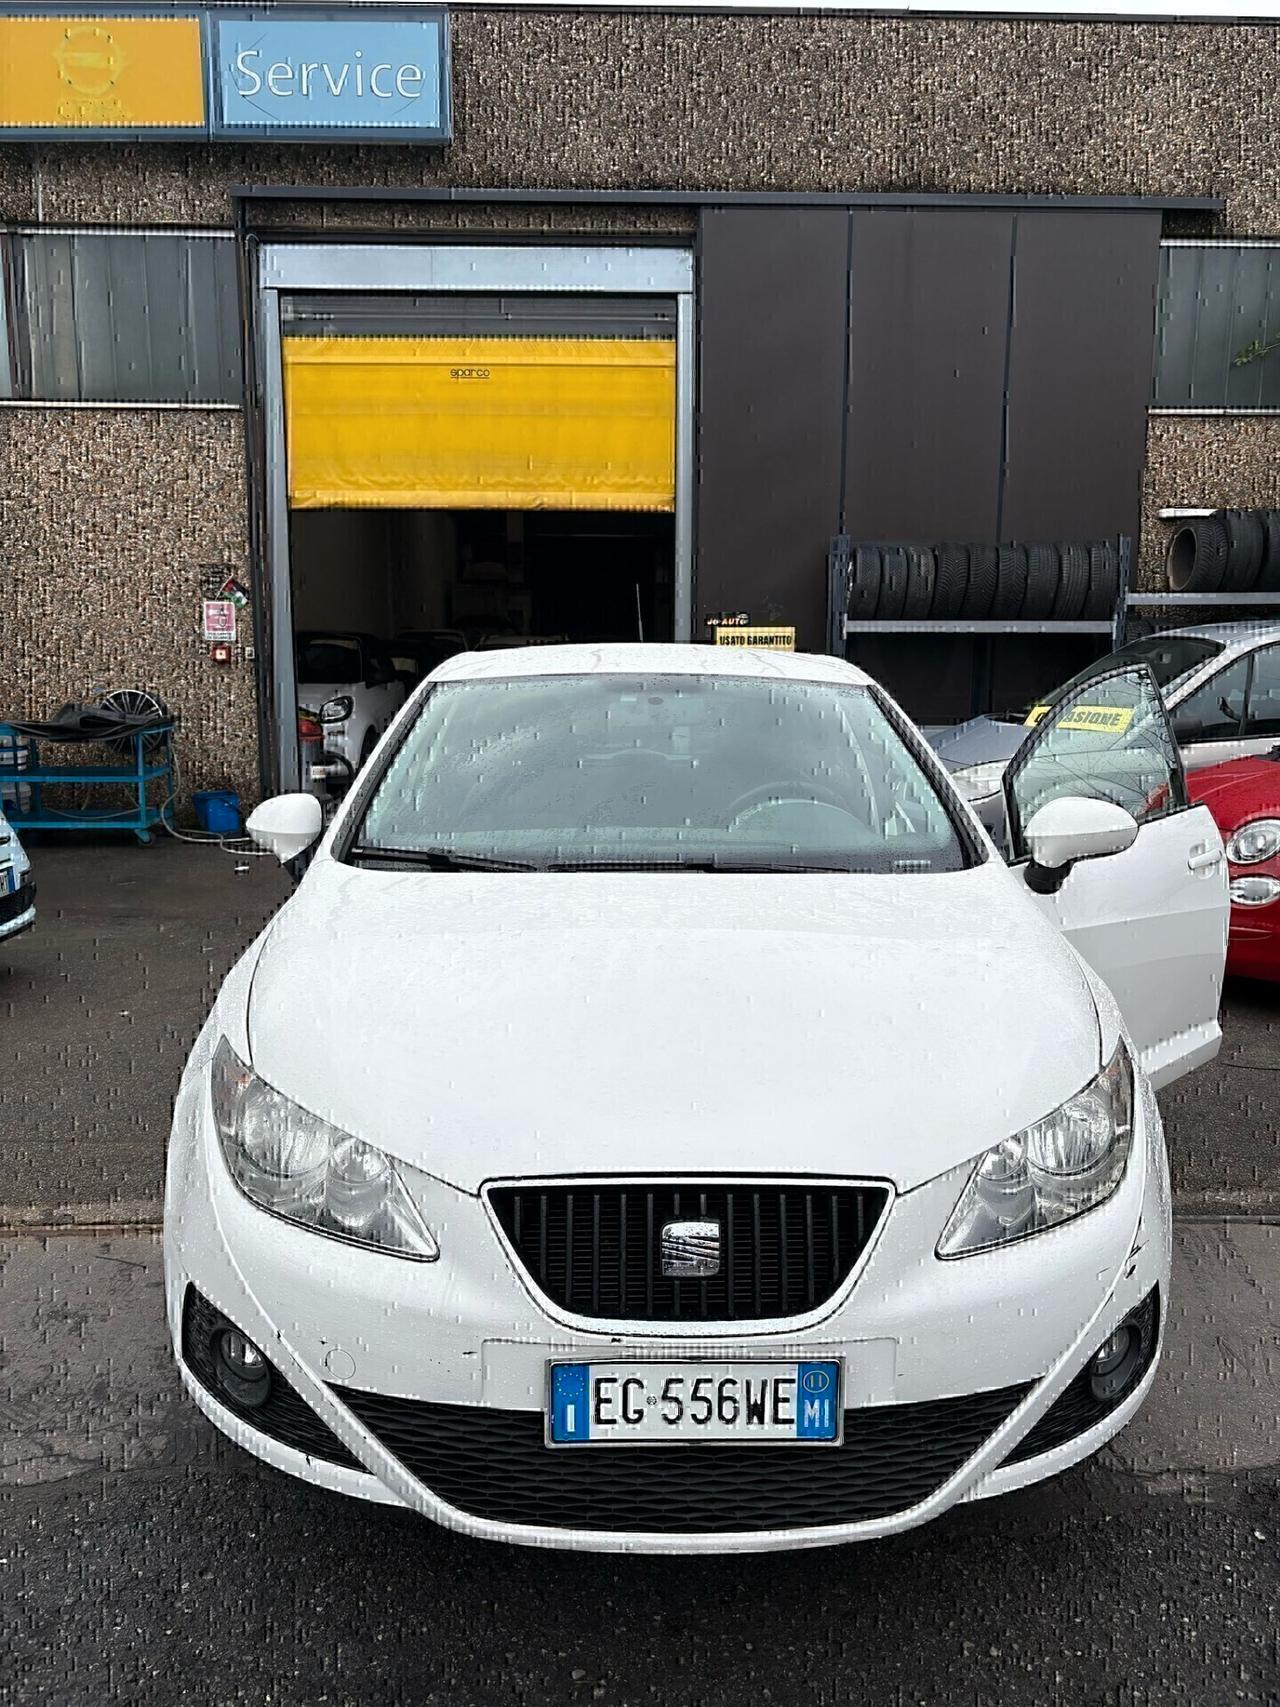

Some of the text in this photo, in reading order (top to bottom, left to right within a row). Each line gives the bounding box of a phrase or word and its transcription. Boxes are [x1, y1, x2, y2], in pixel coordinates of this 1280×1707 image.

[236, 50, 422, 98] Service
[450, 368, 490, 380] sparco
[720, 635, 792, 645] USATO GARANTITO
[594, 1377, 796, 1426] EG 556WE
[804, 1399, 829, 1428] MI
